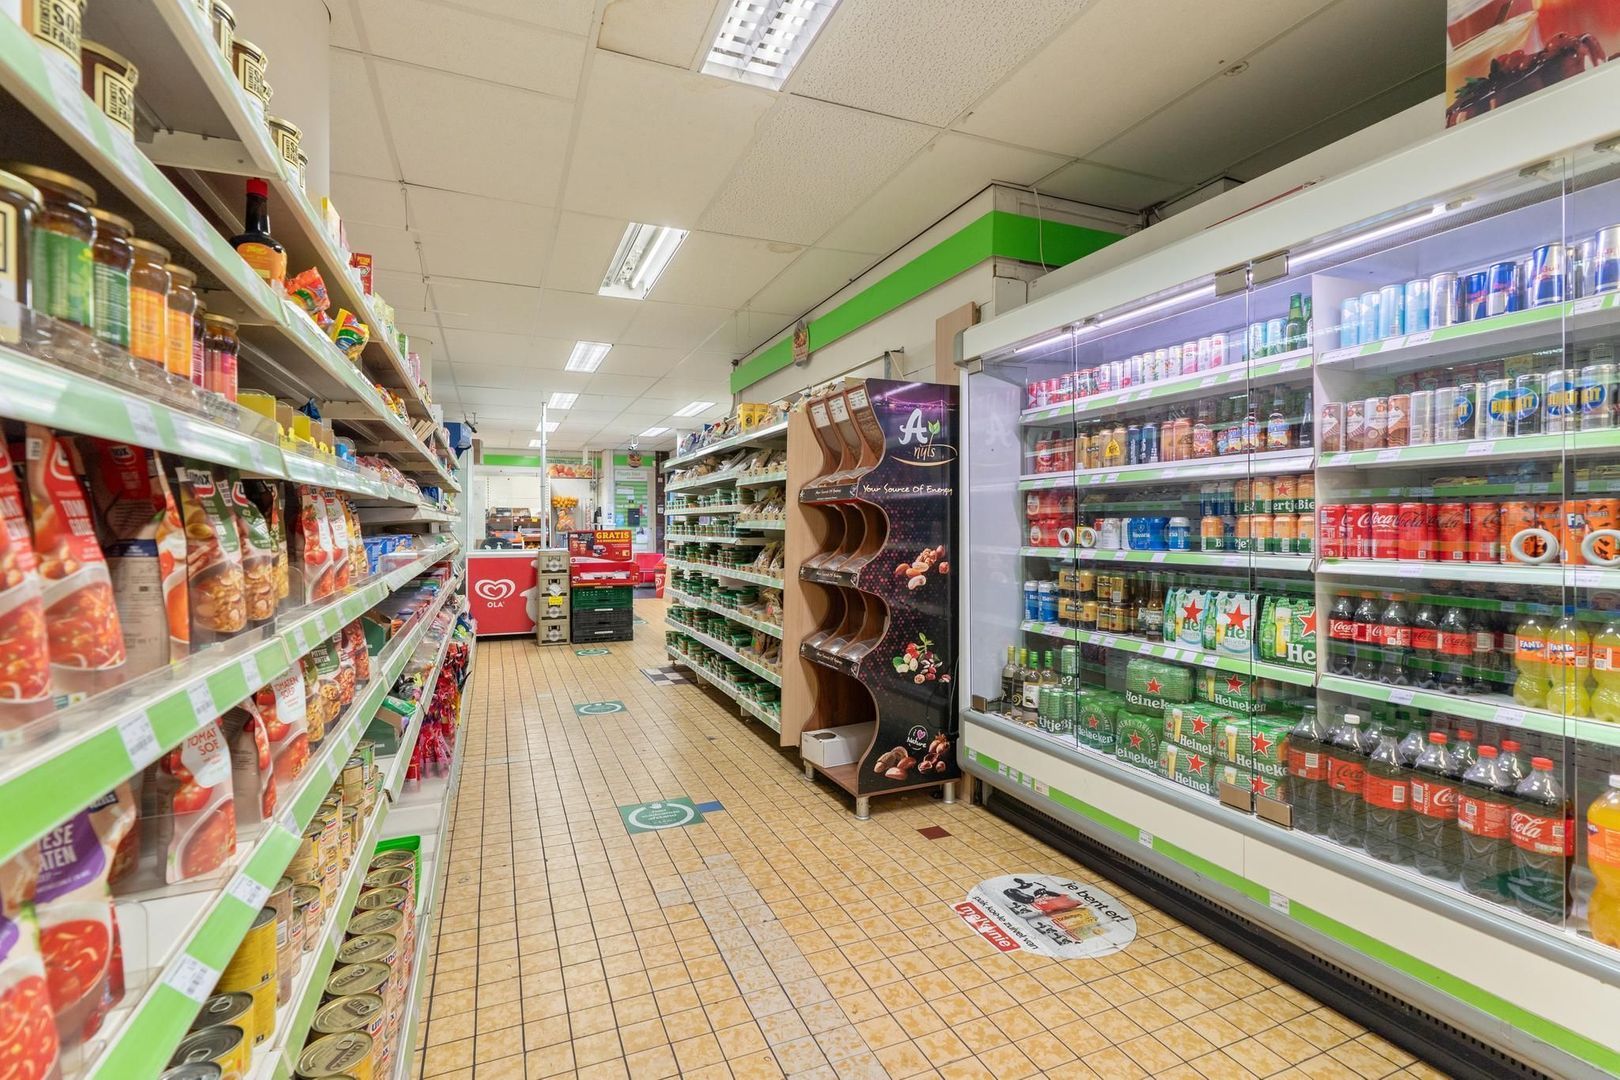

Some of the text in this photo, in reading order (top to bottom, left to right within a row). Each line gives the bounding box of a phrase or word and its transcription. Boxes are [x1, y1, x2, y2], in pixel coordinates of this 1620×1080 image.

[898, 408, 928, 445] A
[863, 483, 952, 496] Your Source Of Energy
[1567, 513, 1586, 527] FA
[596, 531, 630, 540] GRATIS
[907, 736, 927, 748] Nature
[1060, 881, 1129, 923] je bent er!
[1023, 937, 1039, 950] van
